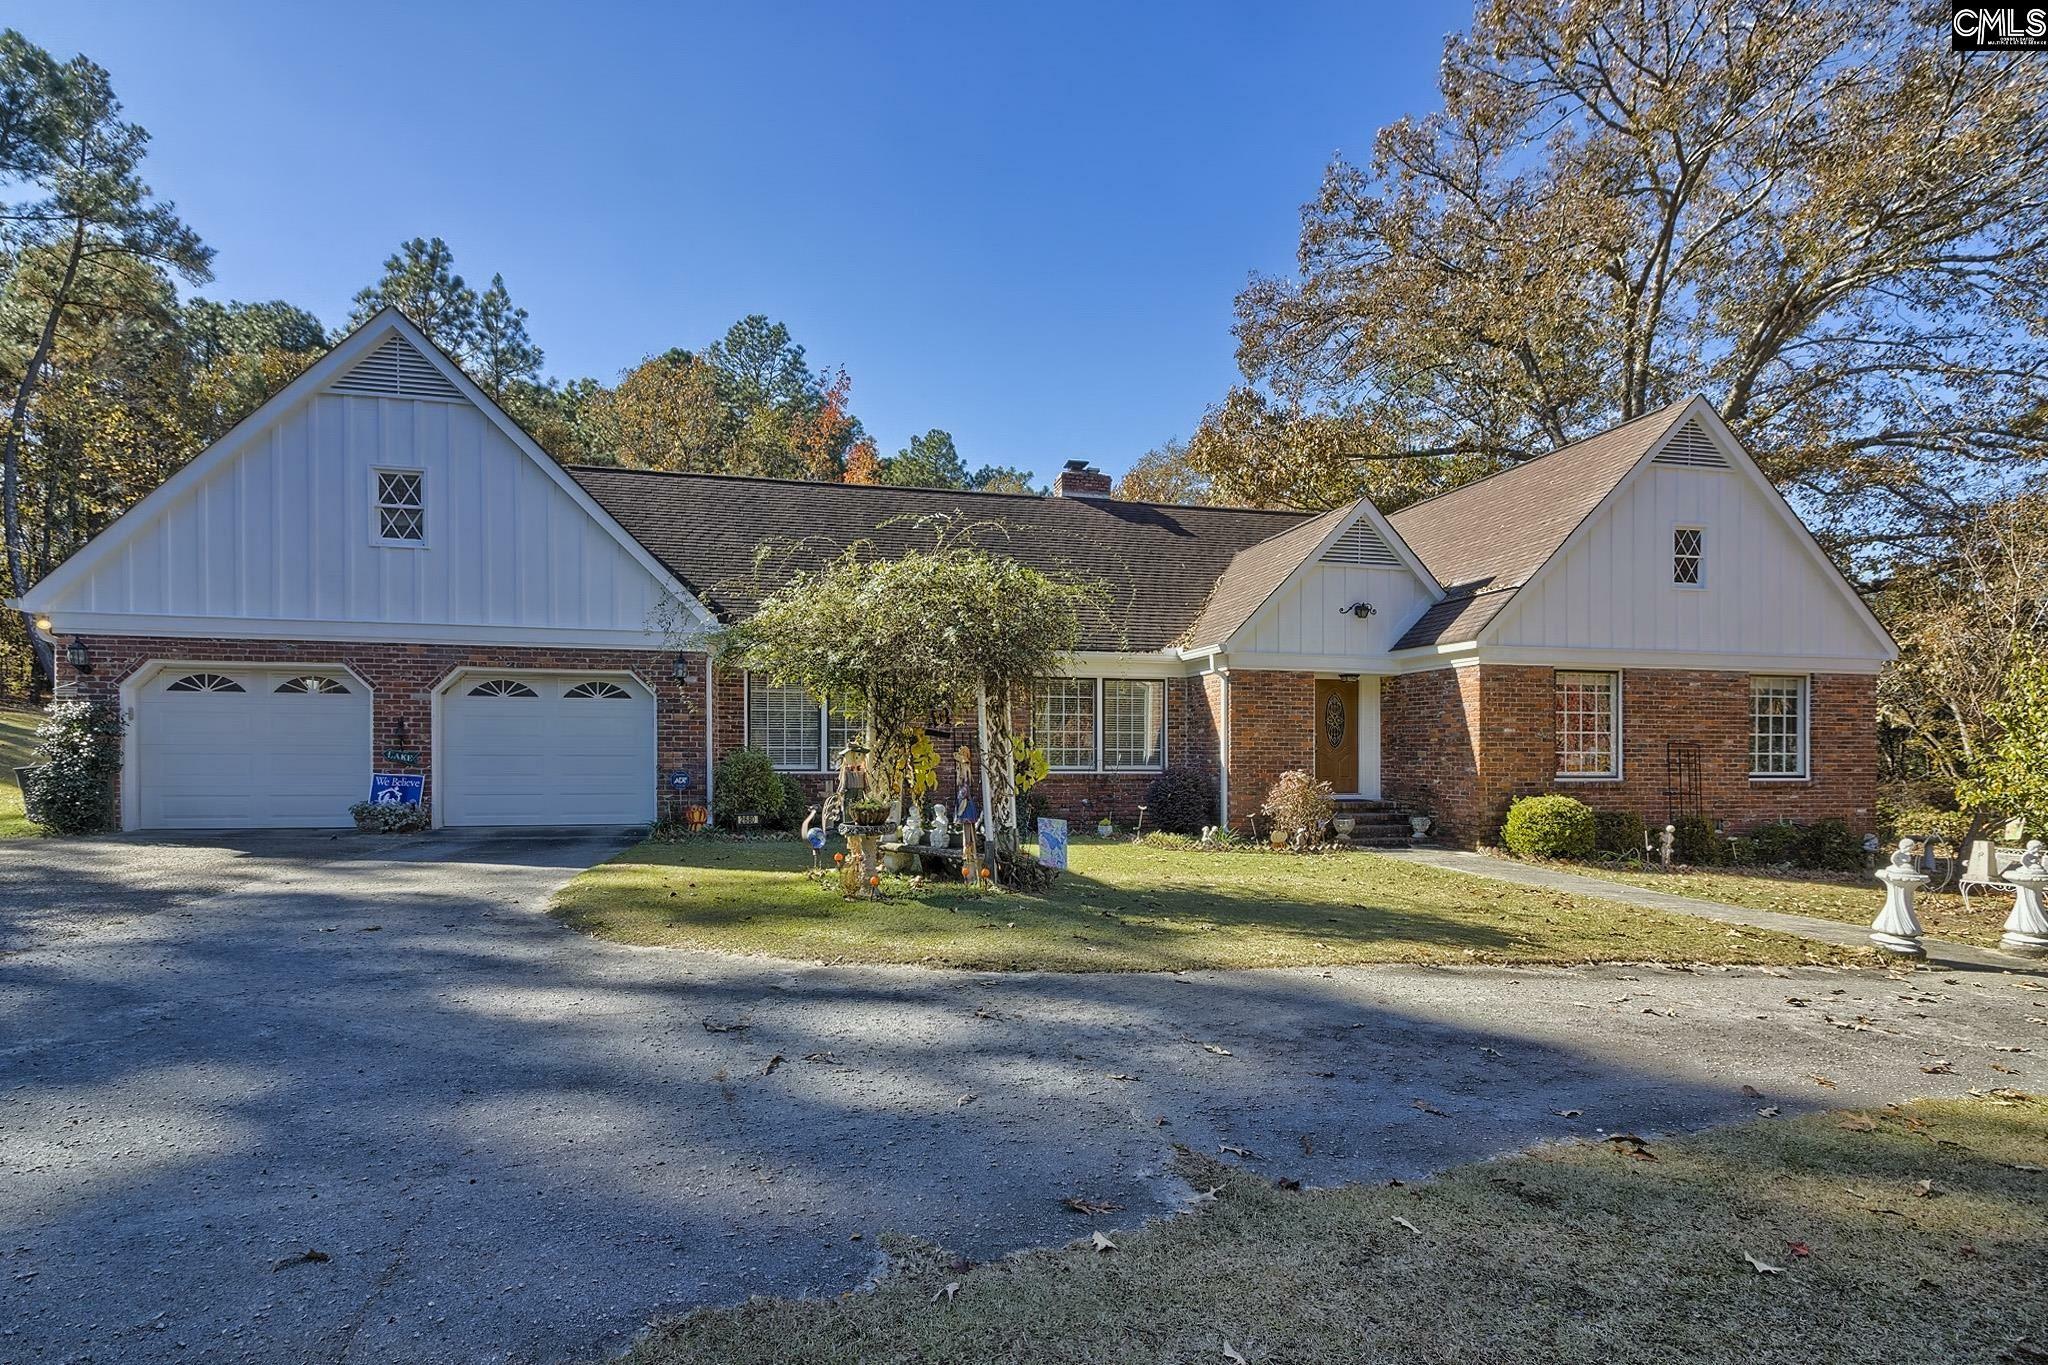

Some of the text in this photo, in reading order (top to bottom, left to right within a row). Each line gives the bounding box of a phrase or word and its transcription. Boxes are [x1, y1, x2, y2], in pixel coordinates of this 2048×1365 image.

[387, 750, 414, 762] LAKE
[376, 776, 421, 788] We Believe
[673, 776, 688, 784] ADT
